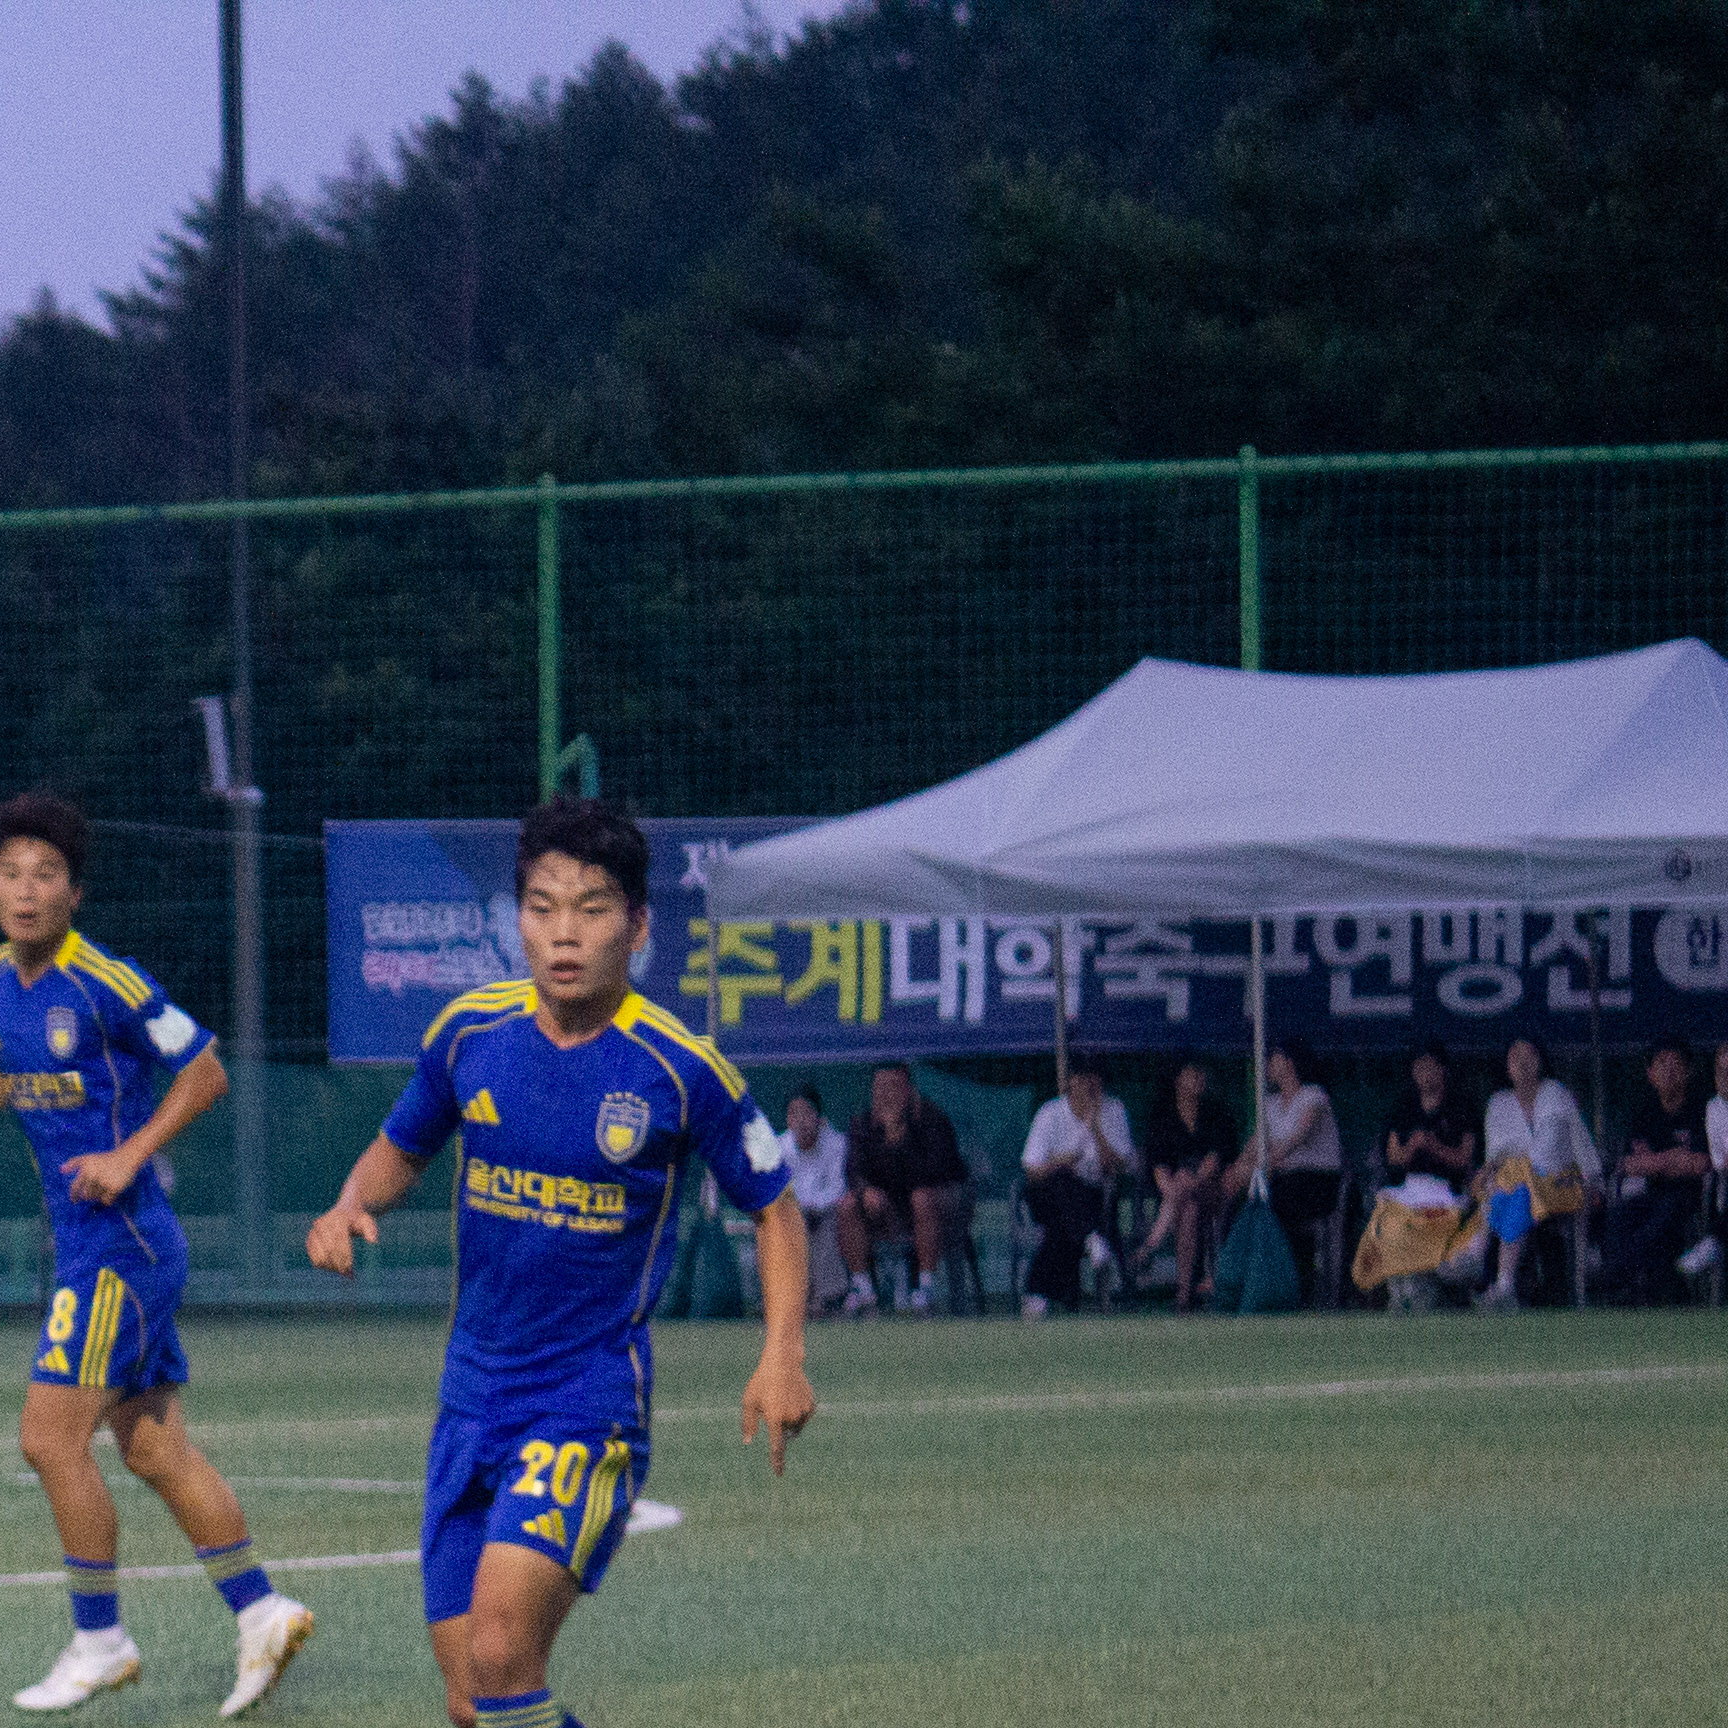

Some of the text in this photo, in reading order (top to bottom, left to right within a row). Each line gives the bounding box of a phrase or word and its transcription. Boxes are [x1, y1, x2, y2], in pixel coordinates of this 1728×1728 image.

[467, 1158, 626, 1214] 울산대학교
[47, 1288, 78, 1342] 8
[511, 1440, 589, 1506] 20
